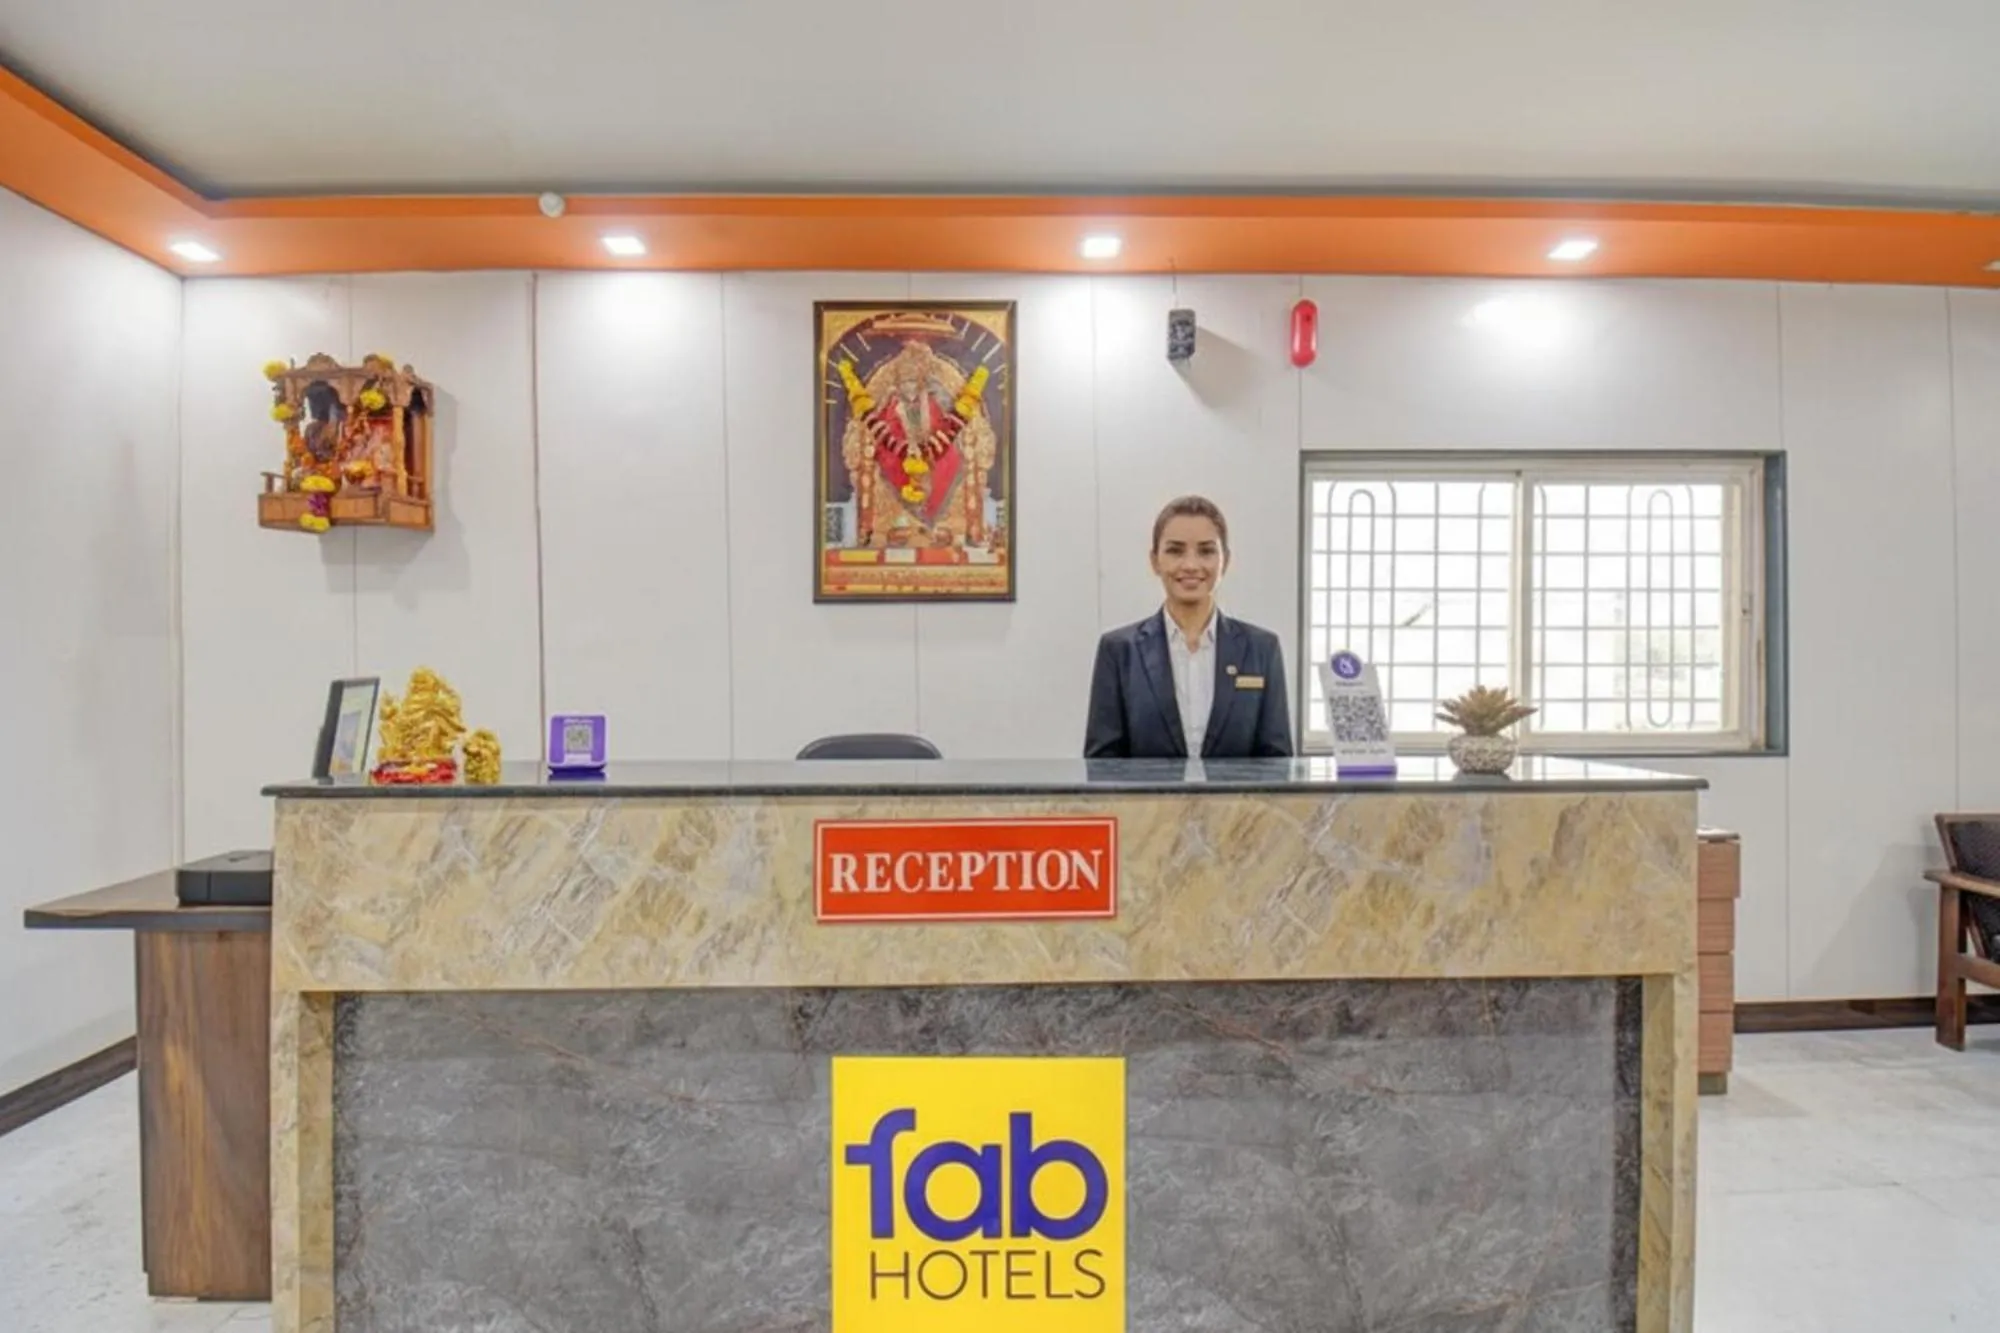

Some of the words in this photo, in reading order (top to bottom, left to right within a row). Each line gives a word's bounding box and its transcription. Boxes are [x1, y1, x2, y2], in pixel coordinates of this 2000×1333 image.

[829, 849, 1103, 893] RECEPTION
[844, 1107, 1109, 1241] fab
[870, 1249, 1106, 1300] HOTELS
